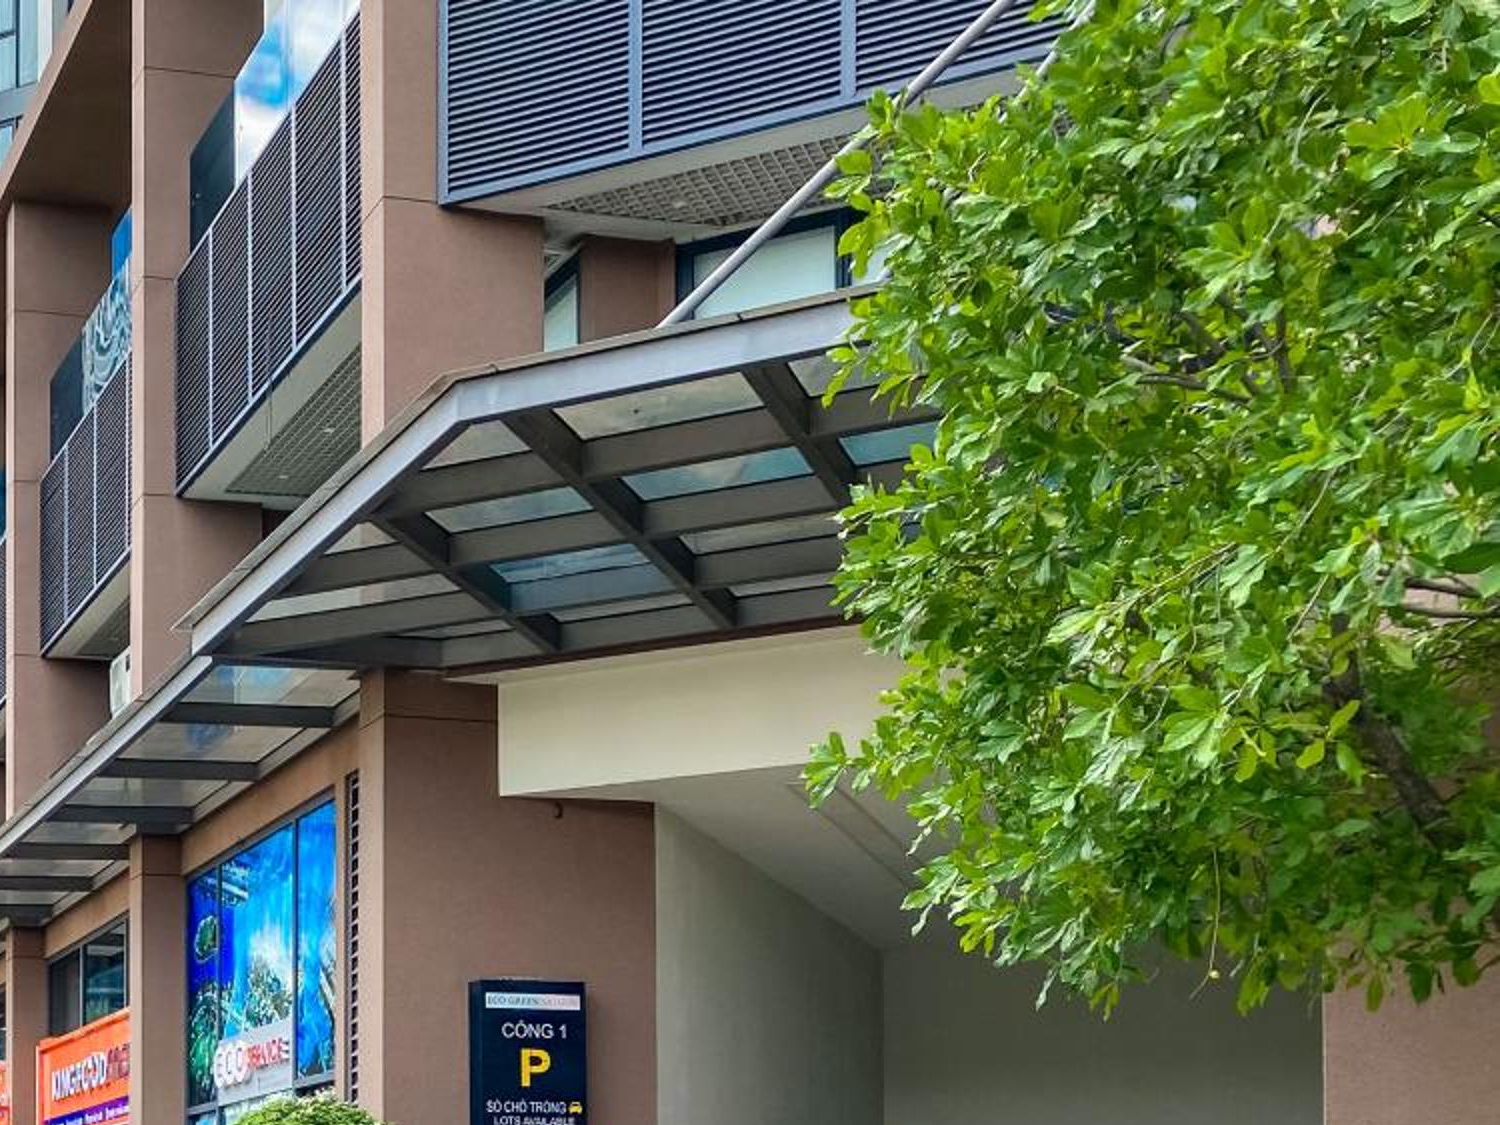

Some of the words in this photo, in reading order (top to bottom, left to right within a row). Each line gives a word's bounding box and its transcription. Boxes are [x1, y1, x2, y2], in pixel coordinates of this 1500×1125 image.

[559, 1024, 567, 1039] 1
[51, 1052, 106, 1102] KINGFOOD
[520, 1047, 551, 1088] P
